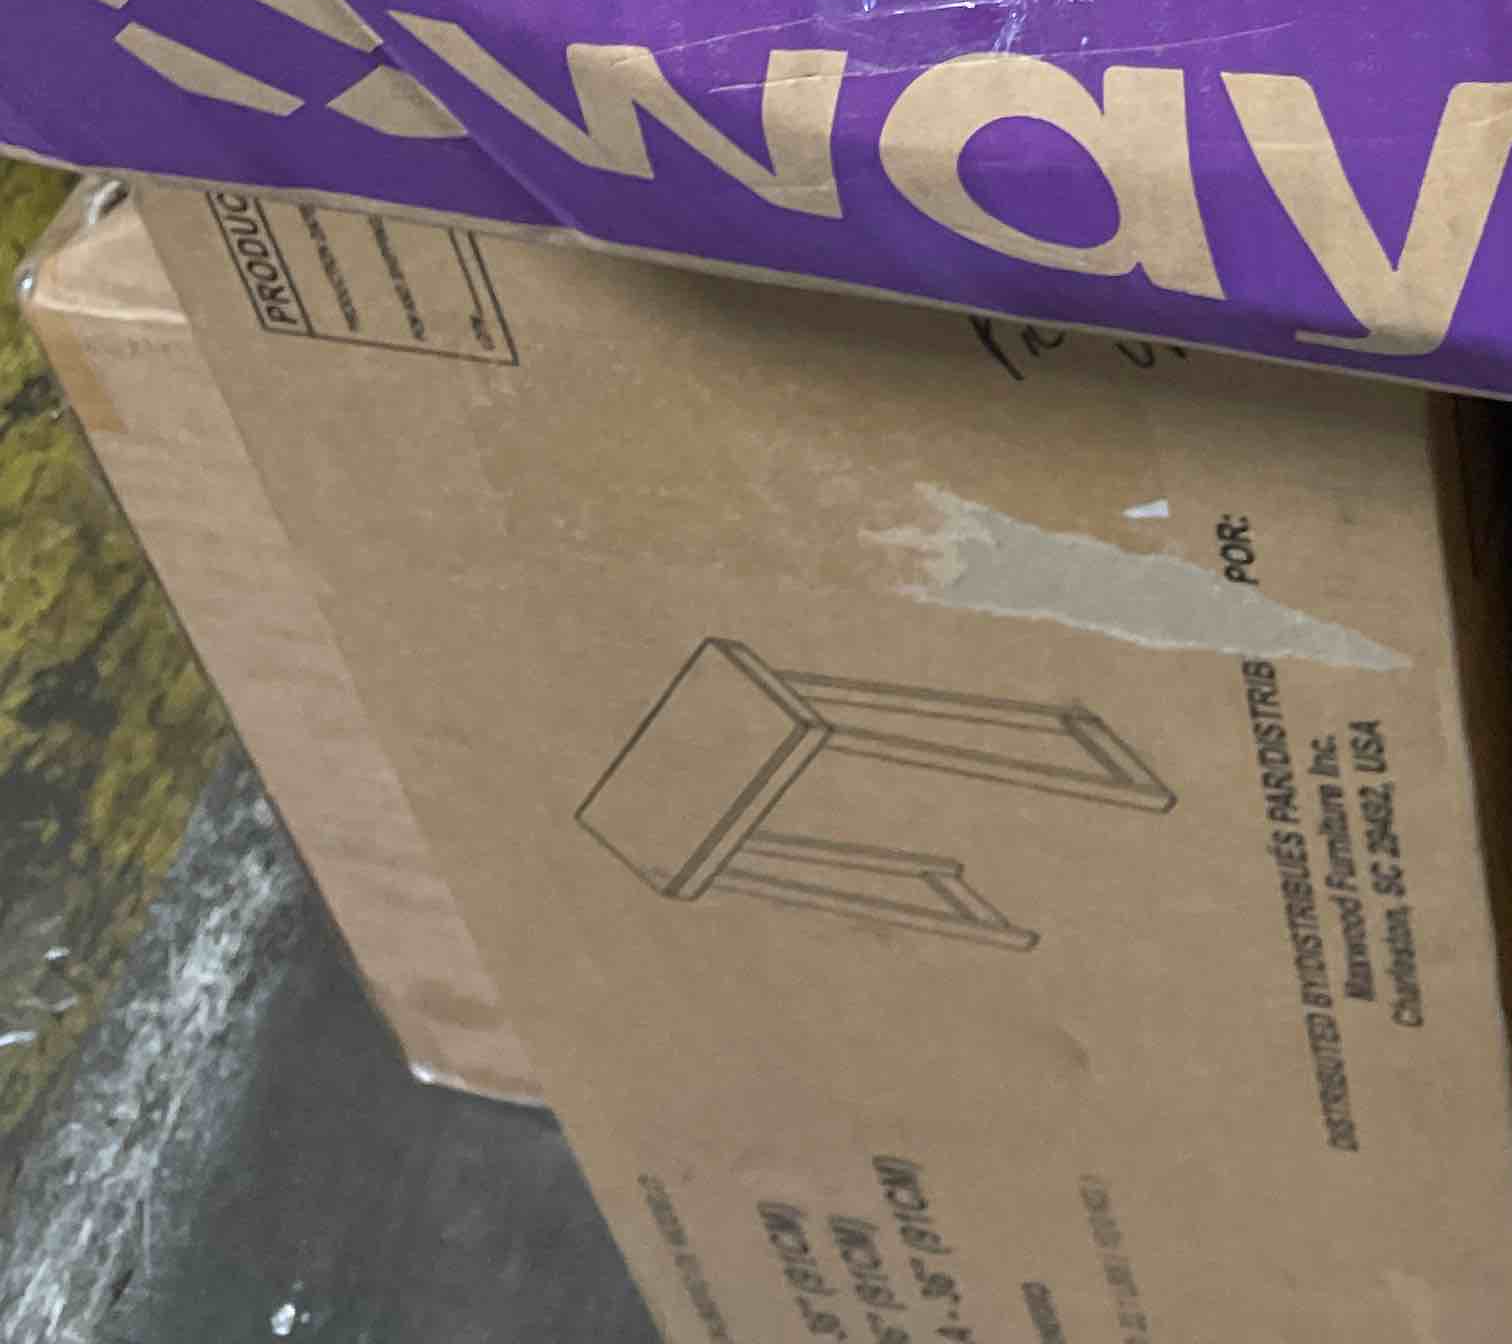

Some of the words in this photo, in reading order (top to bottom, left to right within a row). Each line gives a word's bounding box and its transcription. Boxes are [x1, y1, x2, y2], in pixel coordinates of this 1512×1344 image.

[1216, 513, 1259, 586] POR:
[1308, 733, 1341, 778] Inc.
[1348, 719, 1388, 773] USA
[1318, 784, 1358, 892] Furniture
[1370, 860, 1406, 898] SC
